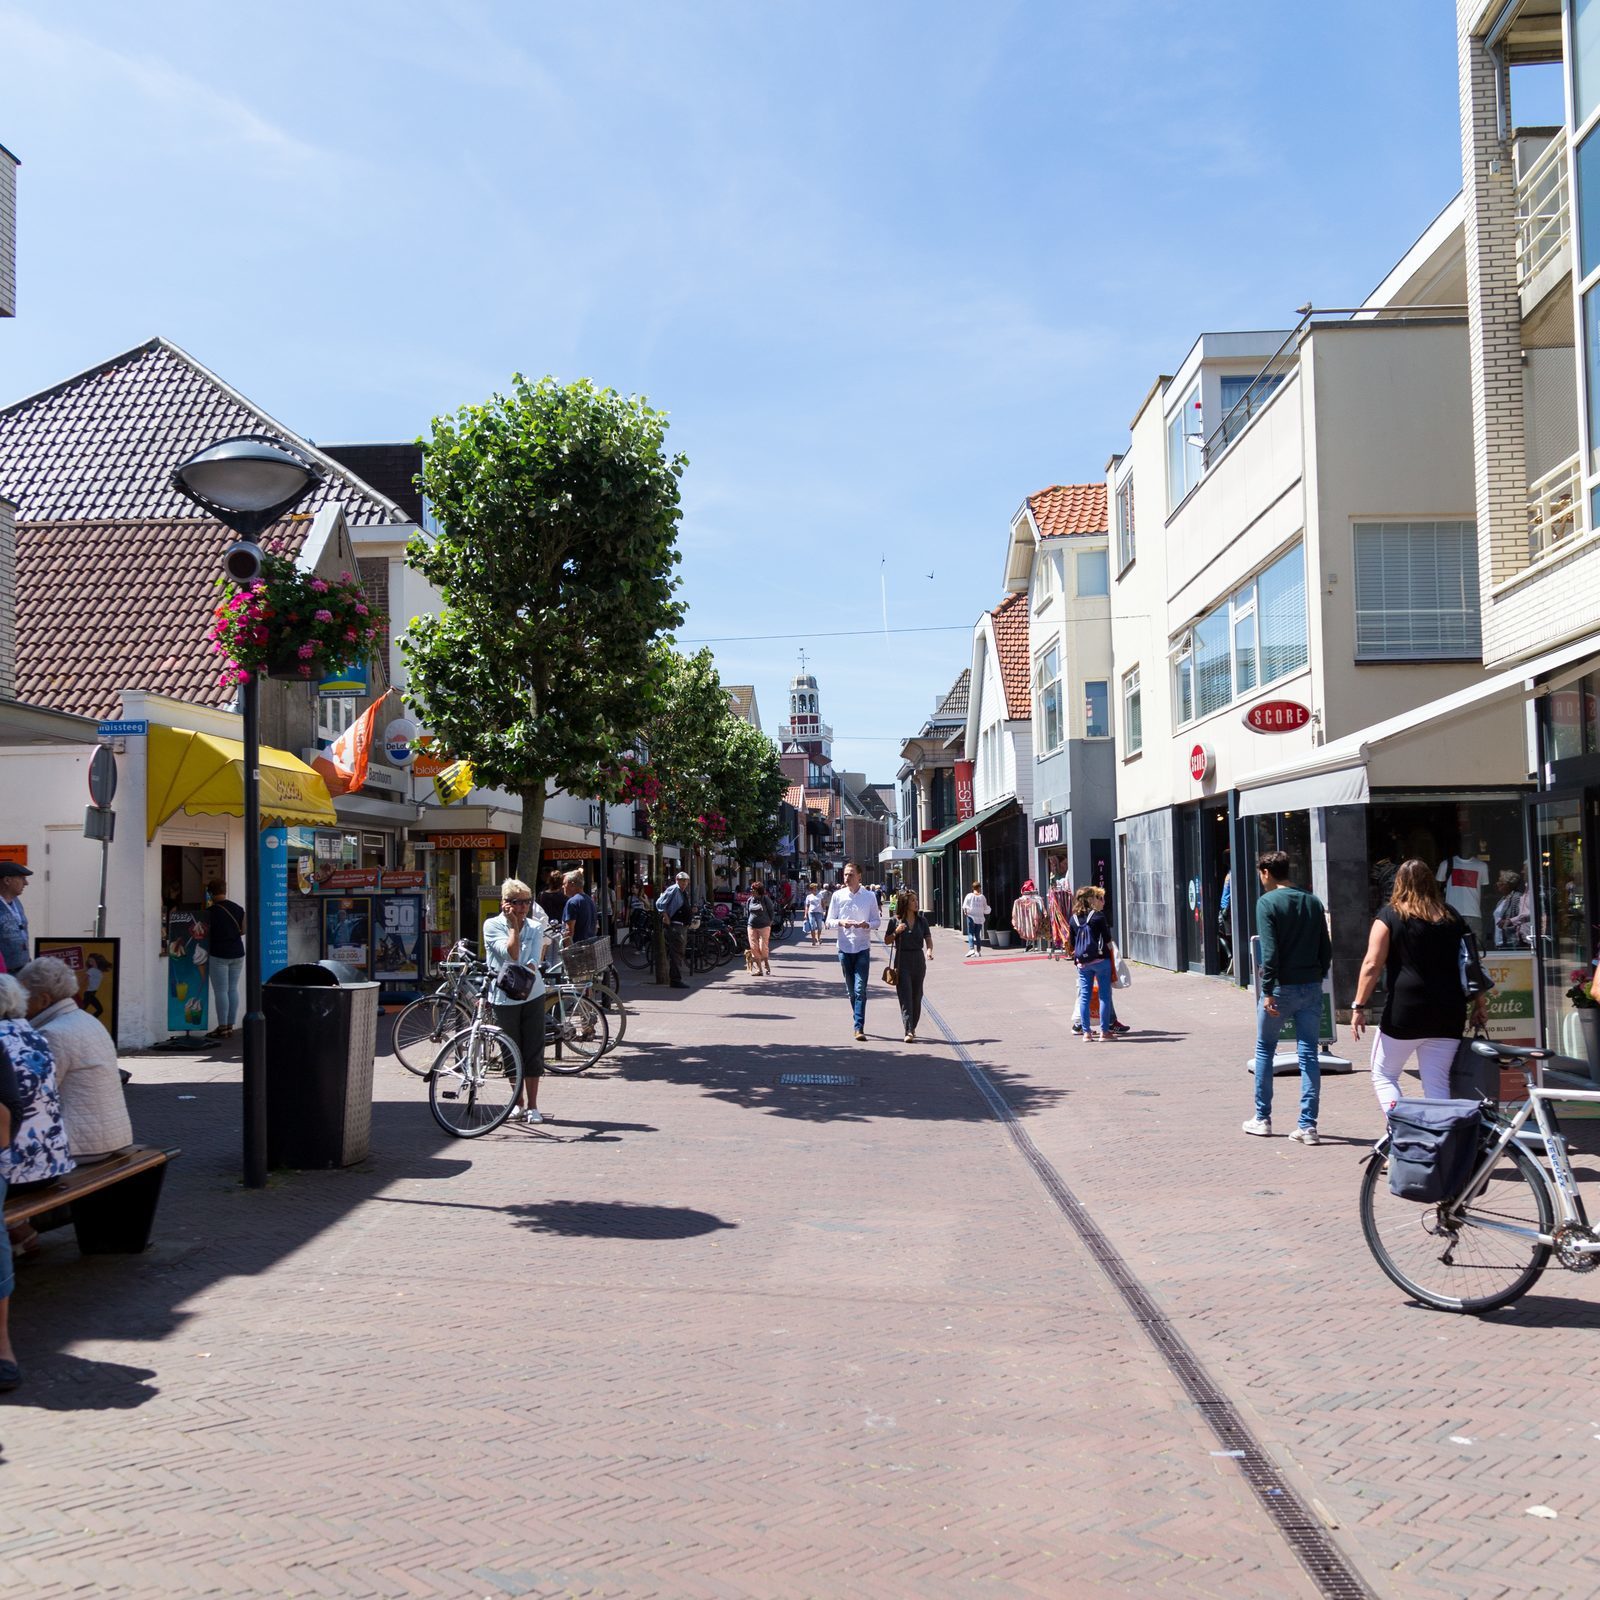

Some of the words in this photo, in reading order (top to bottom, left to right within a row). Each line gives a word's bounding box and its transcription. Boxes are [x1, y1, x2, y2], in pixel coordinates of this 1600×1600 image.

[1254, 708, 1303, 725] SCORE
[1191, 753, 1205, 772] SCORE
[384, 905, 415, 927] 90
